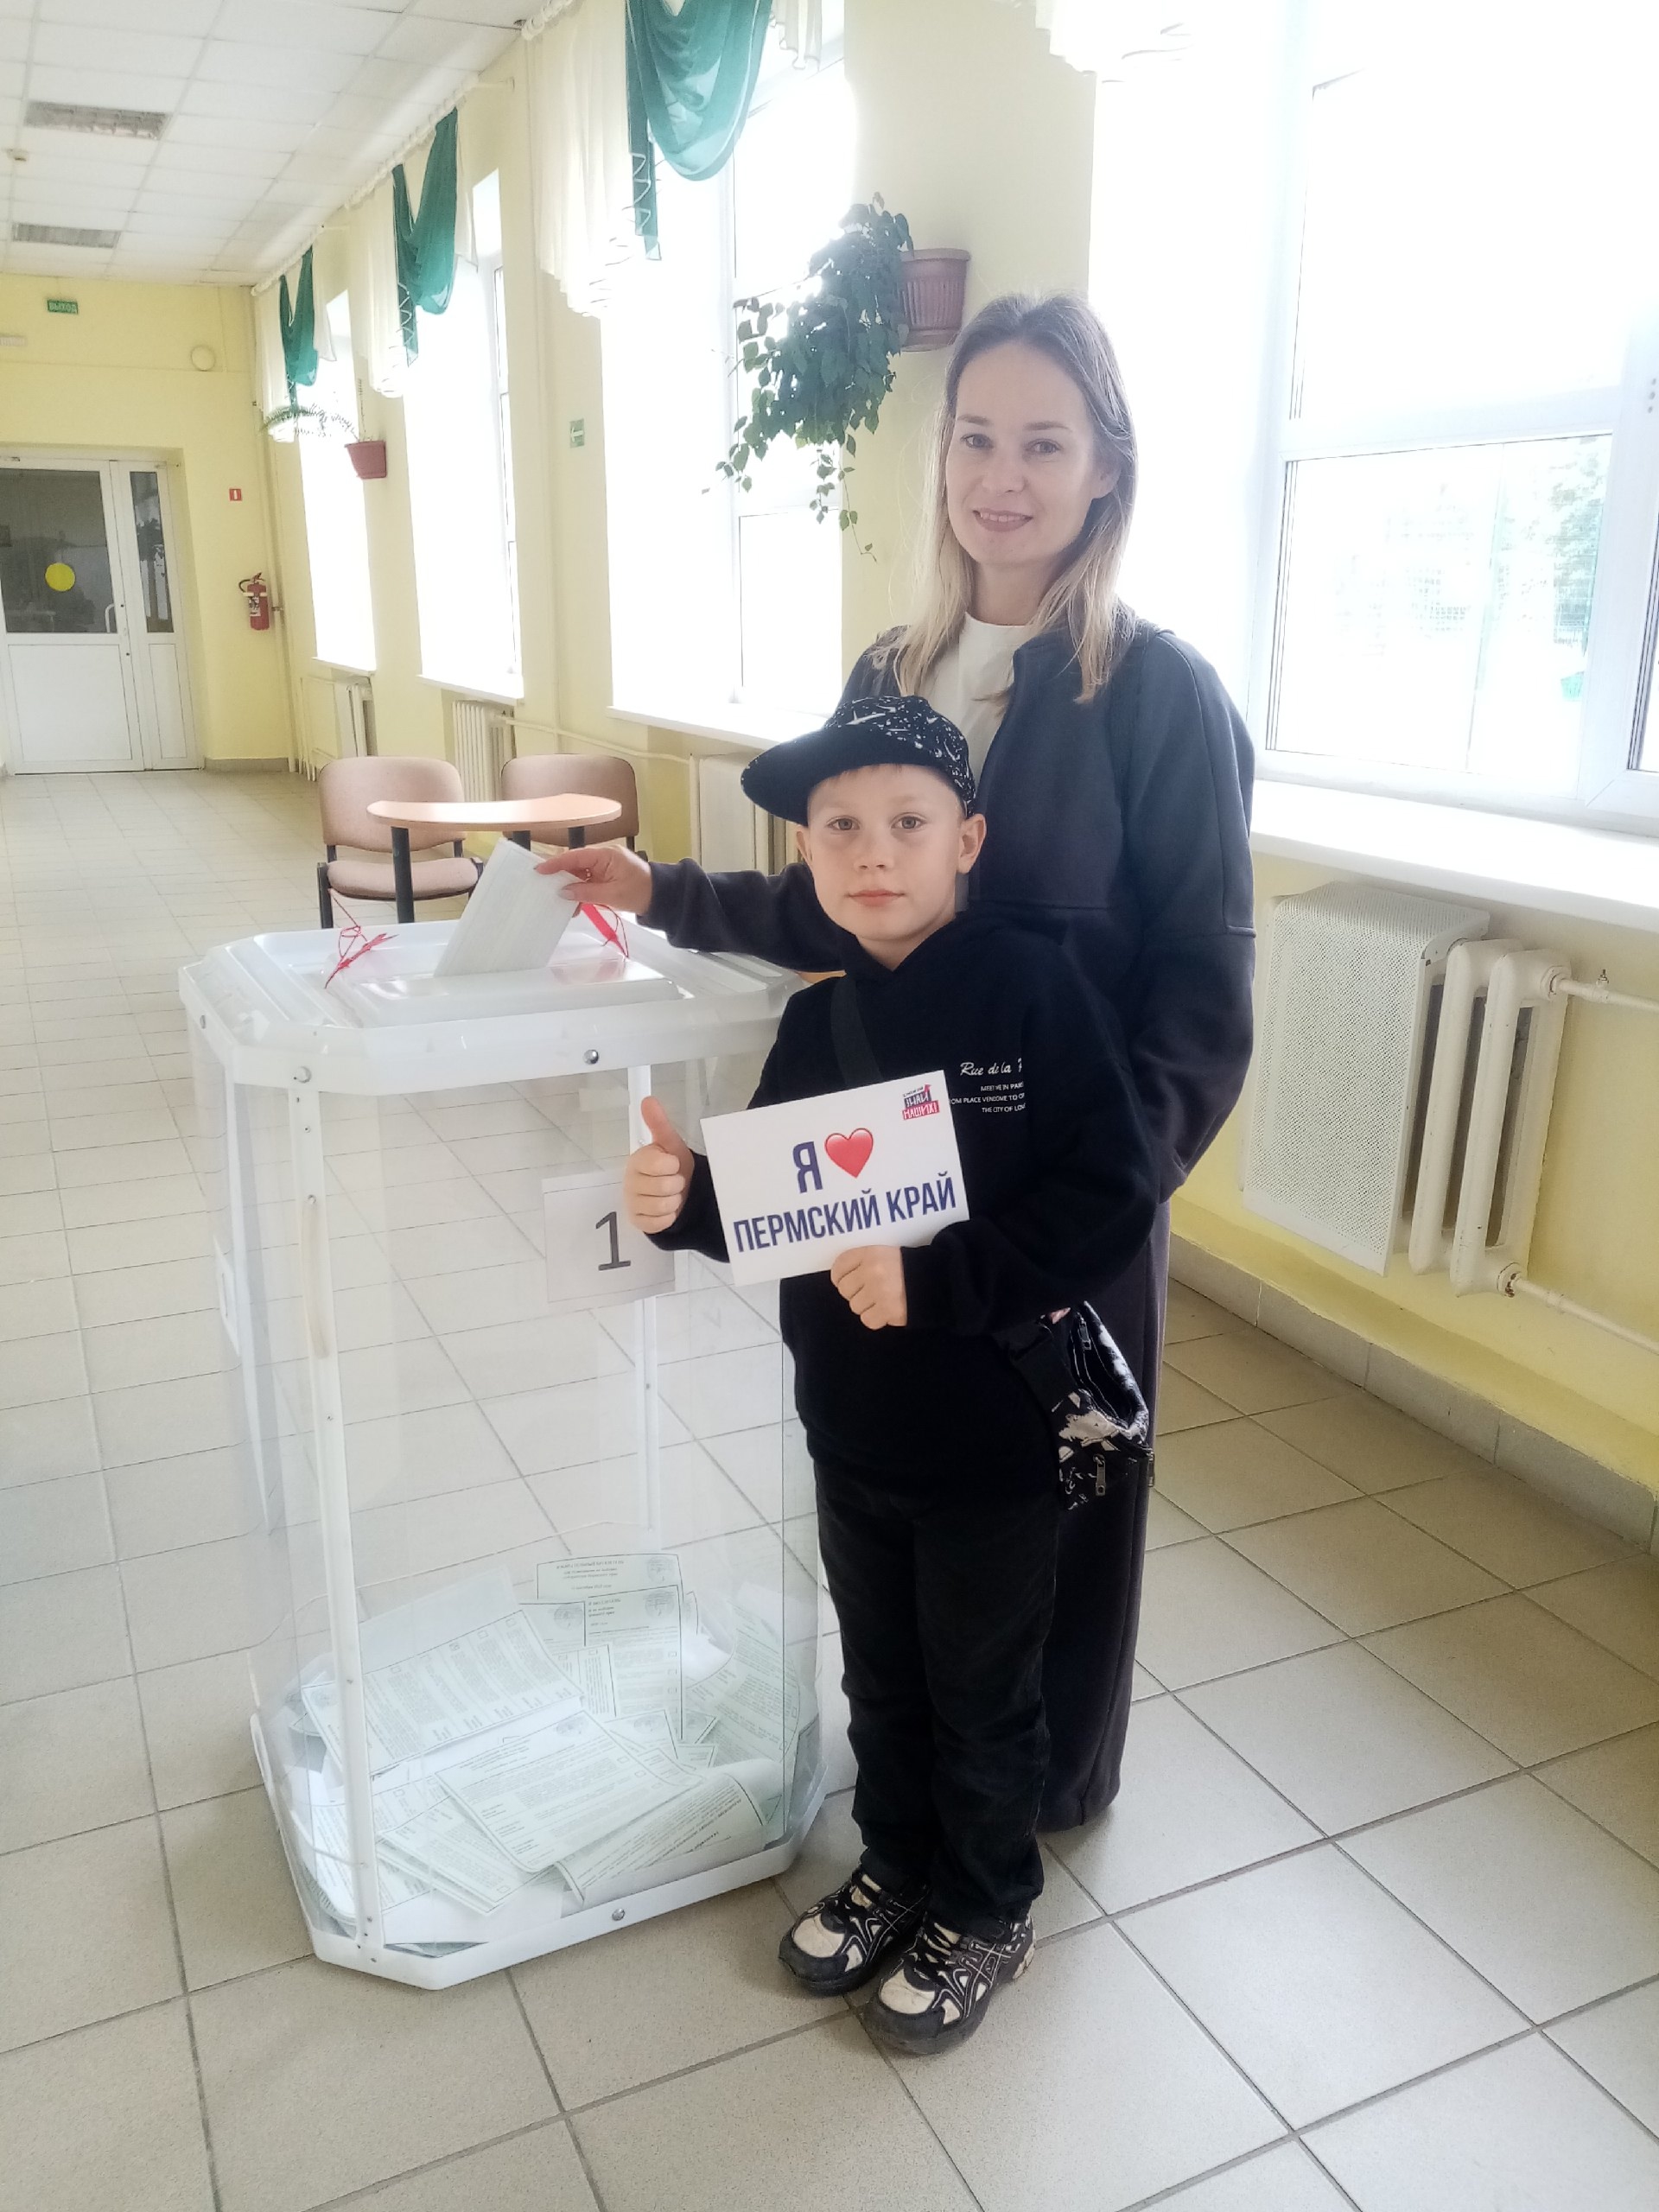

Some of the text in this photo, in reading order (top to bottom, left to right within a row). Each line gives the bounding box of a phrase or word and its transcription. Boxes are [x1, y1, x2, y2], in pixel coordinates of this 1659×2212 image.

[960, 1062, 984, 1076] Rue
[1001, 1061, 1012, 1074] la
[792, 1141, 823, 1193] Я
[733, 1171, 957, 1252] ПЕРМСКИЙ КРАЙ
[595, 1211, 631, 1271] 1
